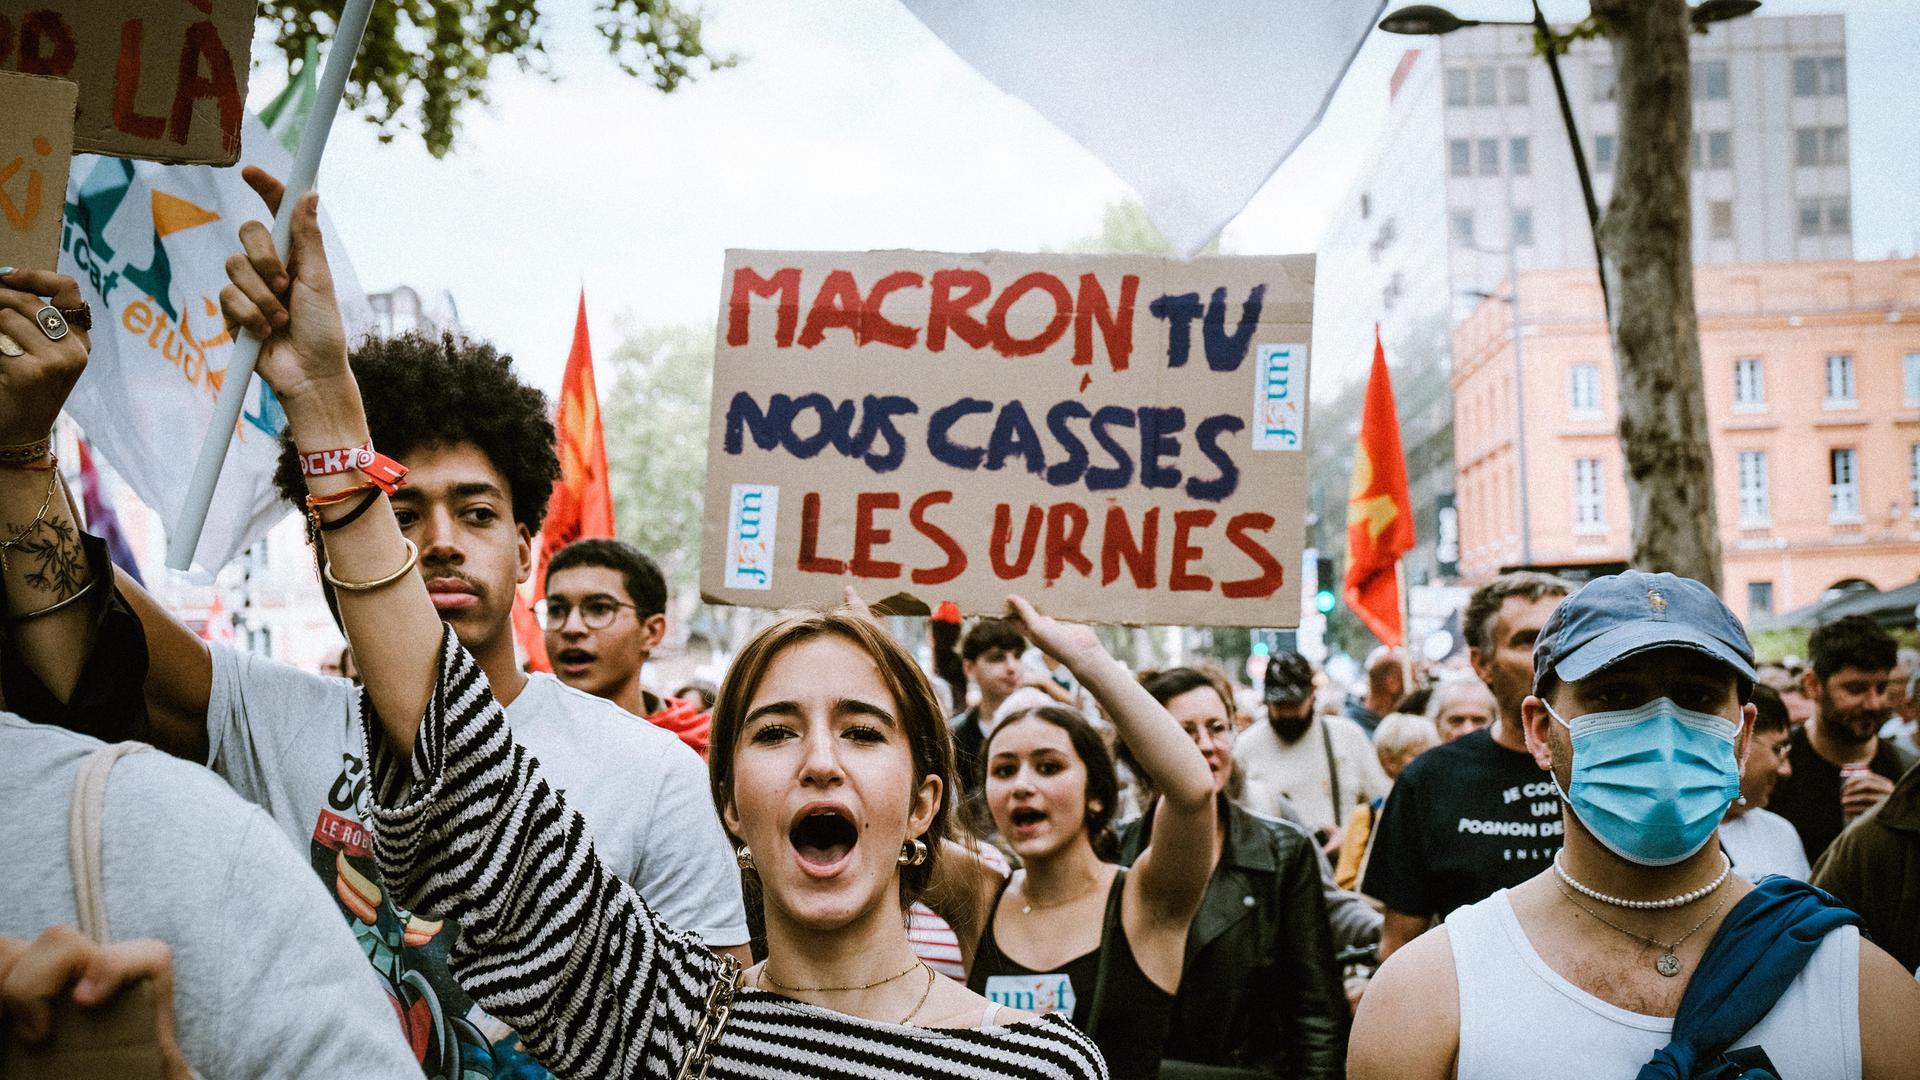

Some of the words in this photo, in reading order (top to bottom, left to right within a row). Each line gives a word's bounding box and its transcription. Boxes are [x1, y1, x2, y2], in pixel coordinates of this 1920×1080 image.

[112, 0, 243, 156] LÀ
[726, 267, 1140, 372] MACRON
[1149, 283, 1268, 372] TU
[724, 391, 919, 474] NOUS
[926, 398, 1246, 503] CASSES
[797, 490, 968, 585] LES
[988, 501, 1284, 599] URNES
[1503, 786, 1521, 804] JE
[1530, 800, 1558, 816] UN
[321, 816, 340, 838] LE
[1458, 817, 1537, 837] POGNON
[1540, 820, 1564, 837] DE
